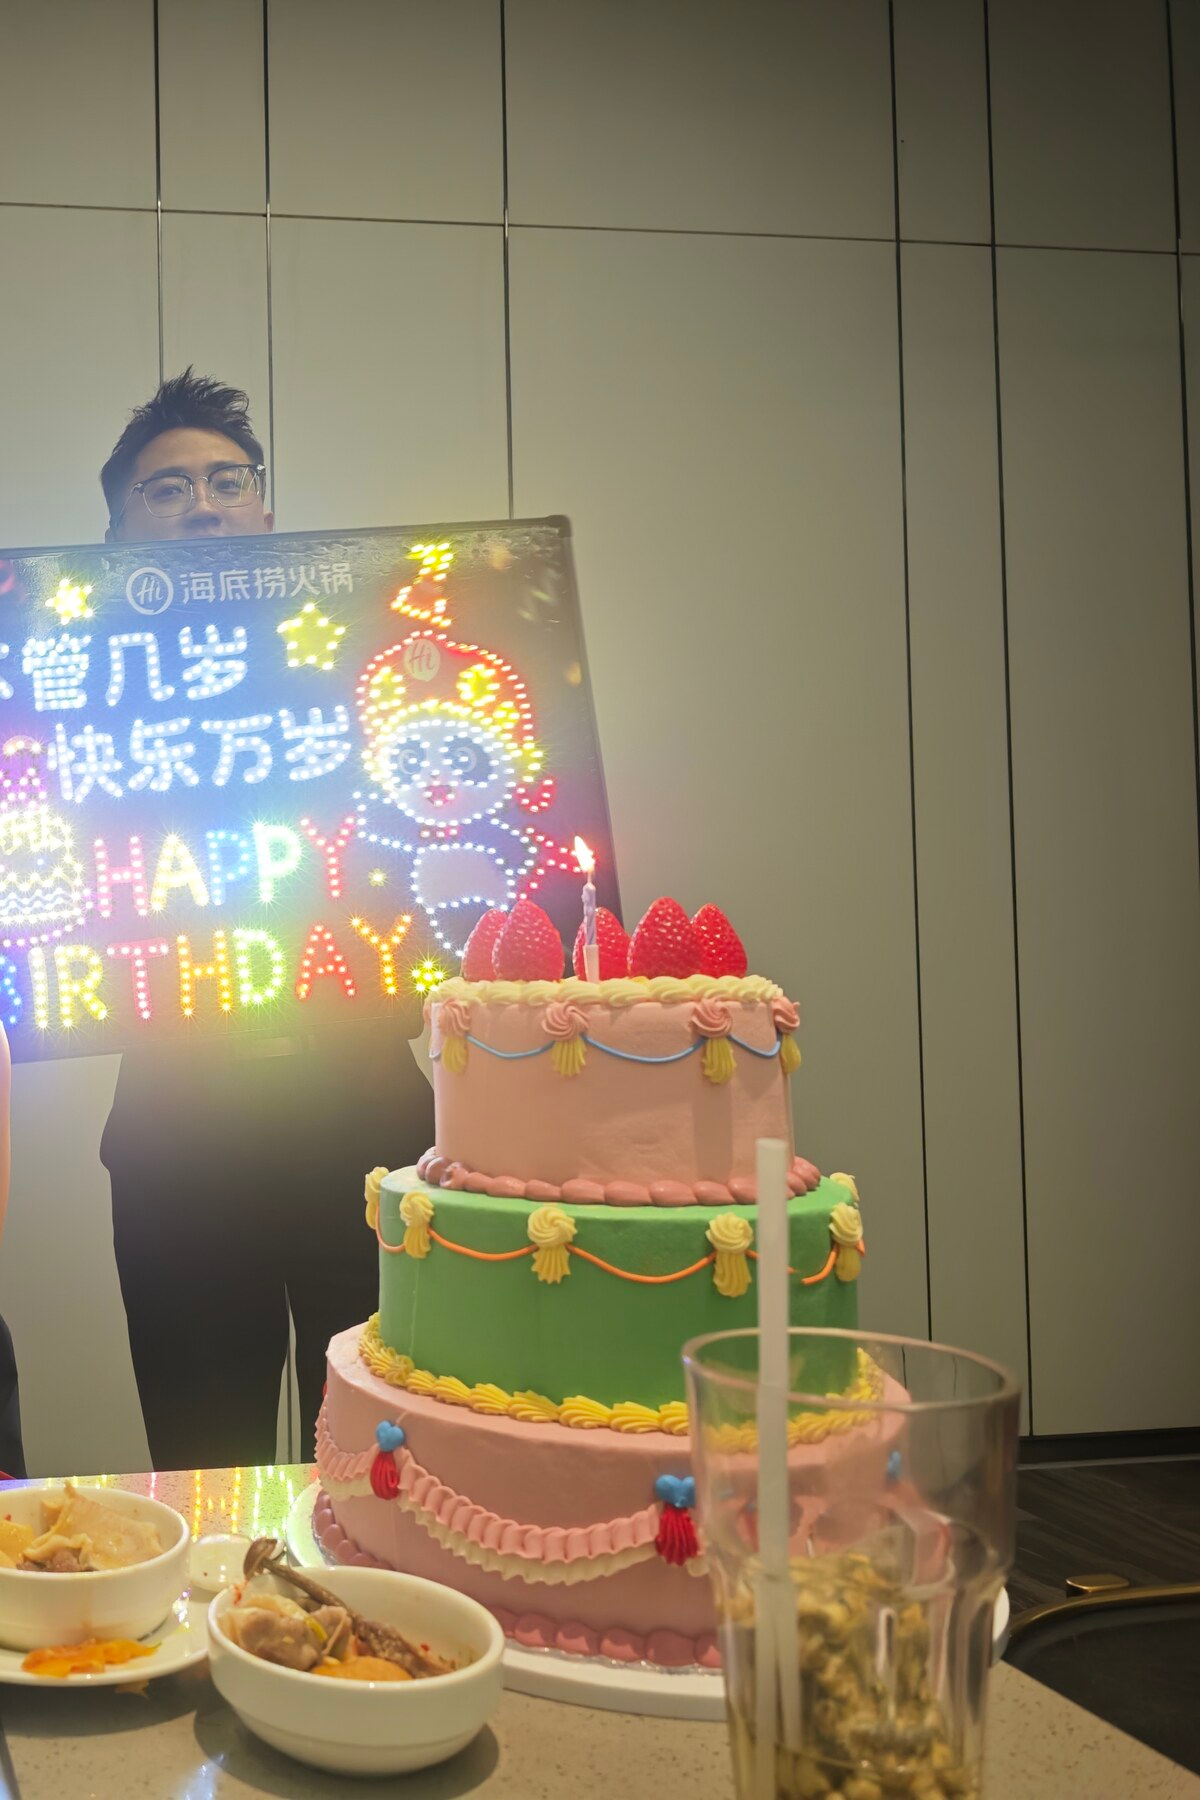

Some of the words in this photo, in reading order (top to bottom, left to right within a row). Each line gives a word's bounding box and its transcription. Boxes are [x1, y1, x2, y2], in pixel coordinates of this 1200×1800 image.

[179, 562, 353, 604] 海底捞火锅
[47, 705, 352, 803] 快乐万岁
[94, 817, 357, 917] HAPPY
